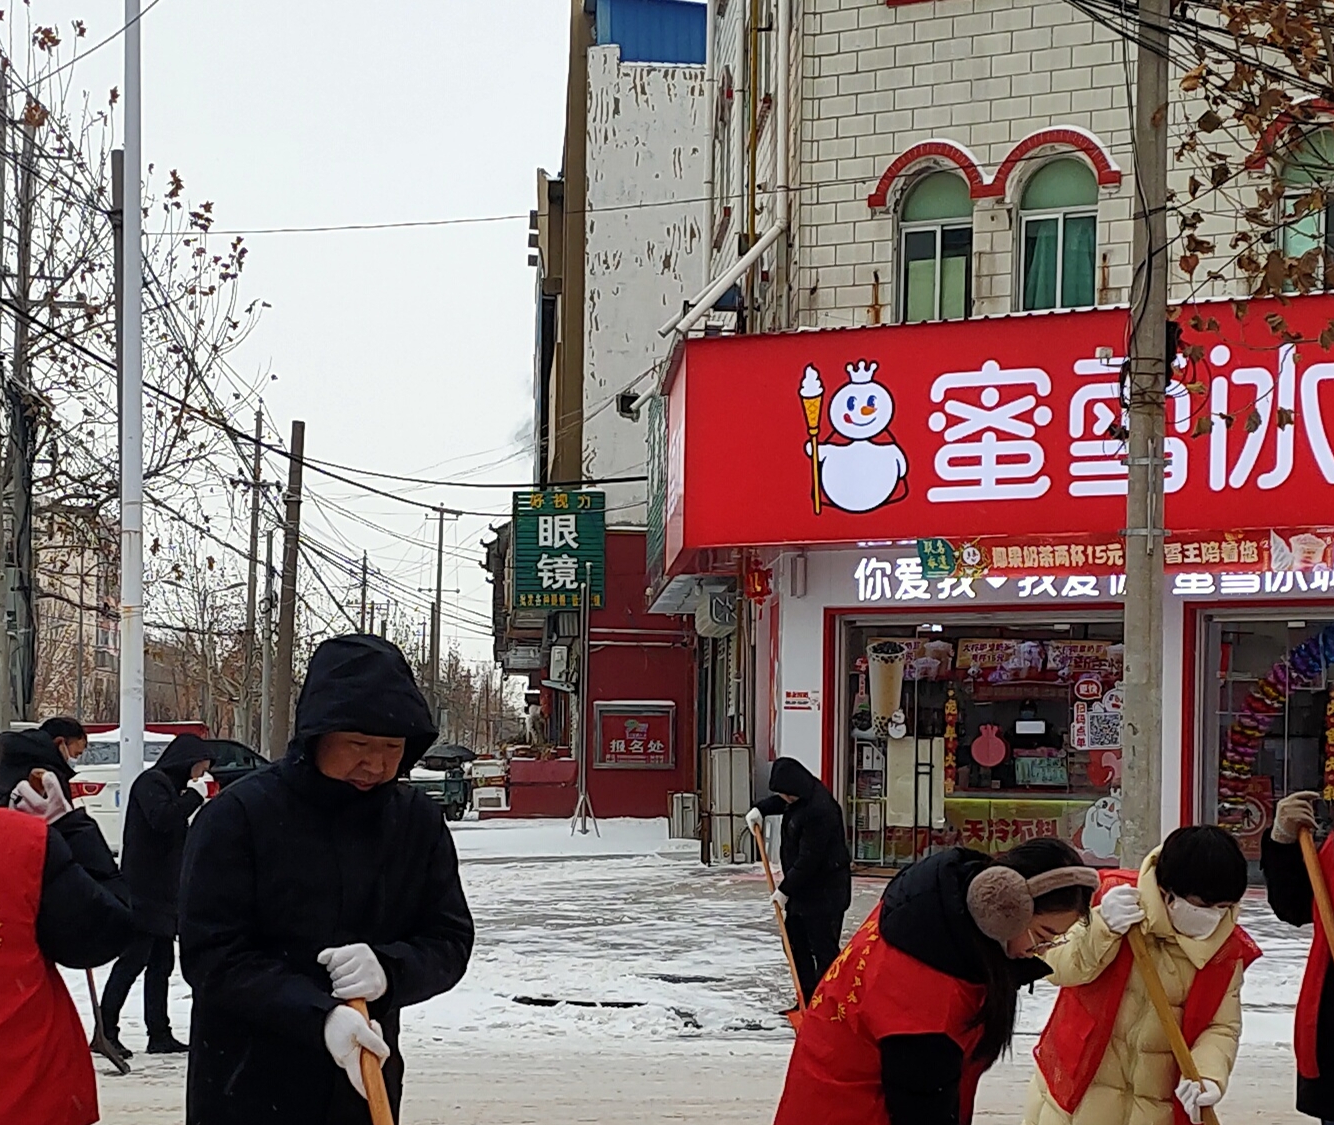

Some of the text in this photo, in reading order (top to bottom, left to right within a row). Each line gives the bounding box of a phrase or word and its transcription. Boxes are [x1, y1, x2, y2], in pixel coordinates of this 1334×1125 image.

[530, 494, 591, 509] 好视力
[537, 514, 580, 589] 眼镜
[992, 544, 1124, 568] 椰果奶茶两杯15元
[609, 739, 665, 753] 报名处
